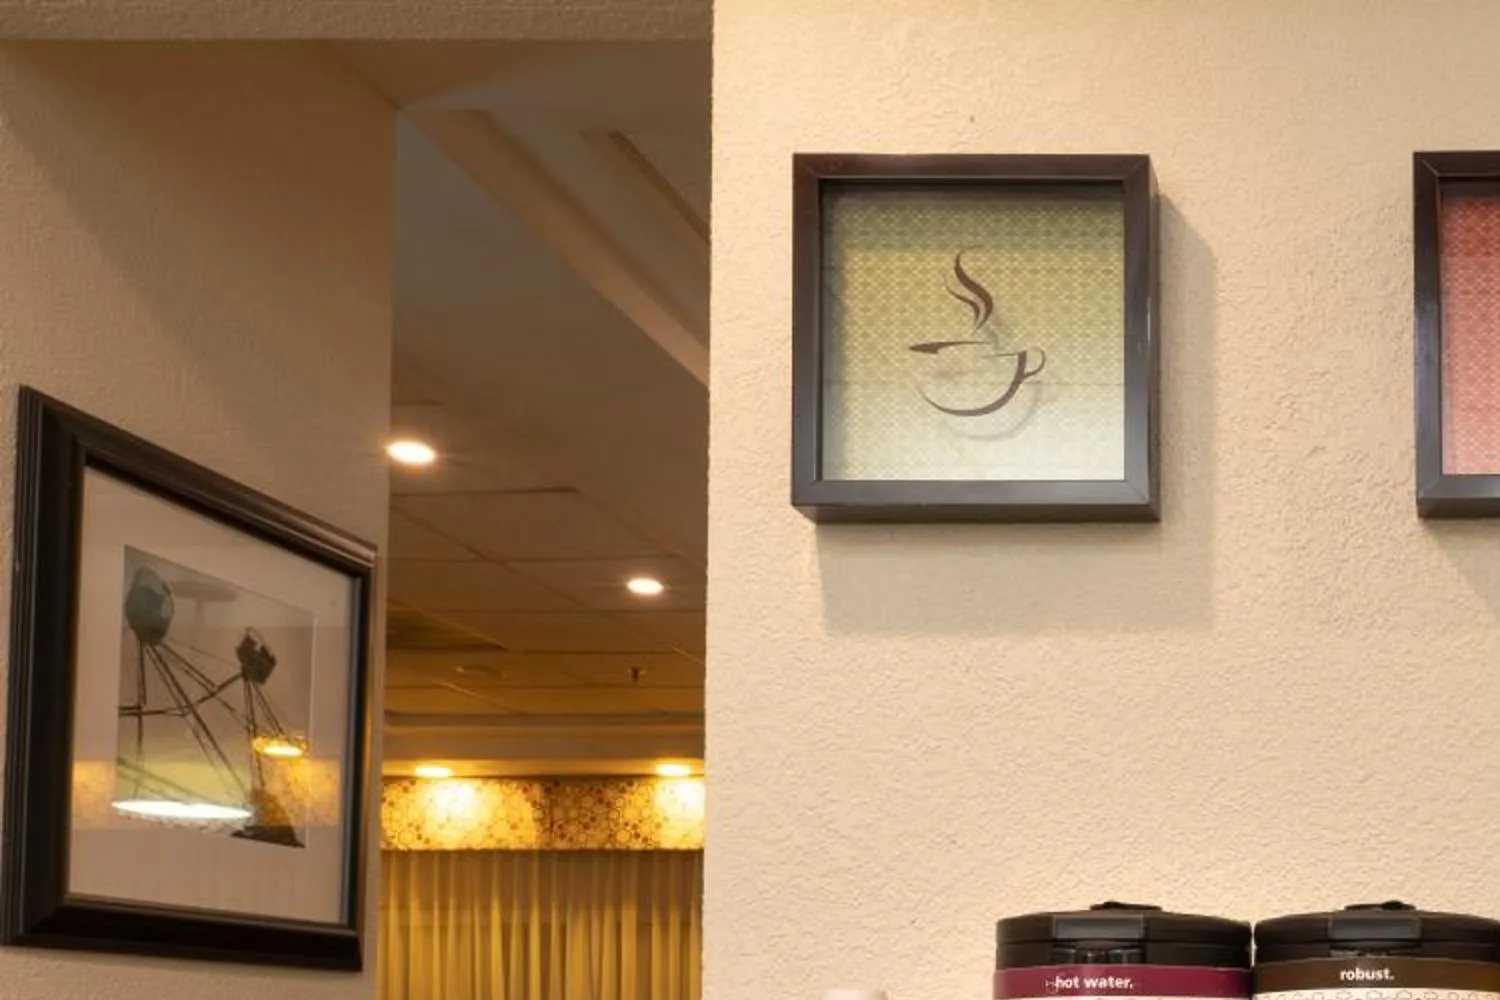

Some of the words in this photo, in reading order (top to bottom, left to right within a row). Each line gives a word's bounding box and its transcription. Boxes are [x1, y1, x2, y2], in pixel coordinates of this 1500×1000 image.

[1340, 967, 1395, 981] robust.
[1055, 975, 1079, 989] hot
[1083, 975, 1134, 989] water.
